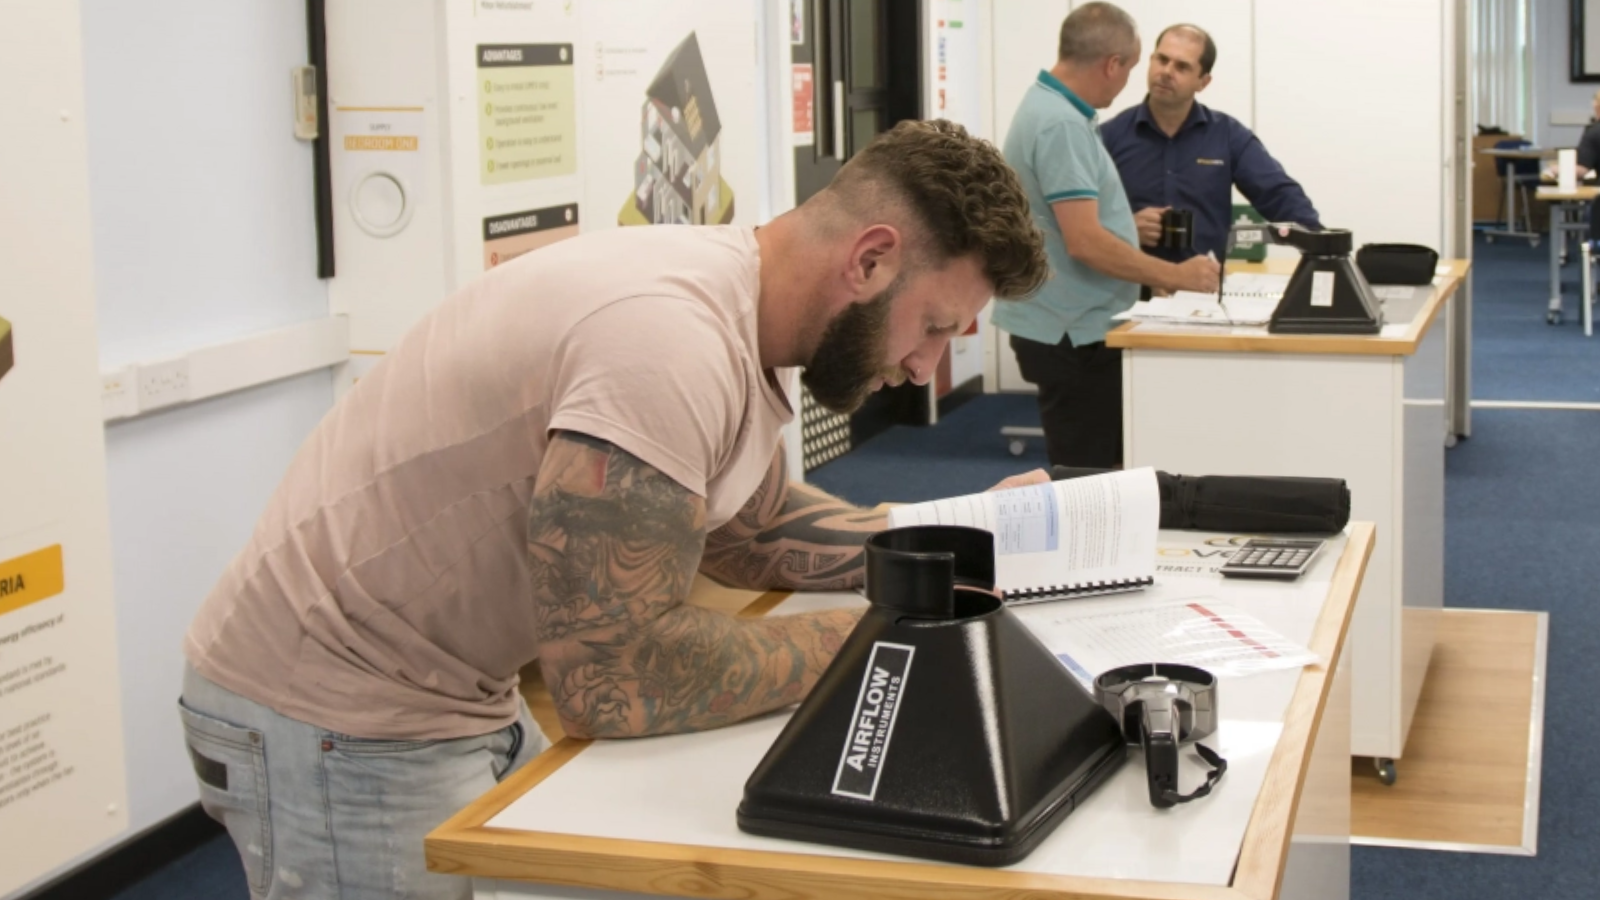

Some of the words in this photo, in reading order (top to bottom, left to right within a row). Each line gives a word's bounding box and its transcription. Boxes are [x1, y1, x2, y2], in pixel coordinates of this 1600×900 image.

[482, 49, 524, 62] ADVANTAGES
[369, 123, 392, 132] SUPPLY
[346, 137, 394, 149] BEDROOM
[395, 137, 417, 149] ONE
[488, 214, 538, 235] DISADVANTAGES
[0, 573, 26, 598] RIA
[846, 666, 890, 773] AIRFLOW
[867, 675, 901, 769] INSTRUMENTS
